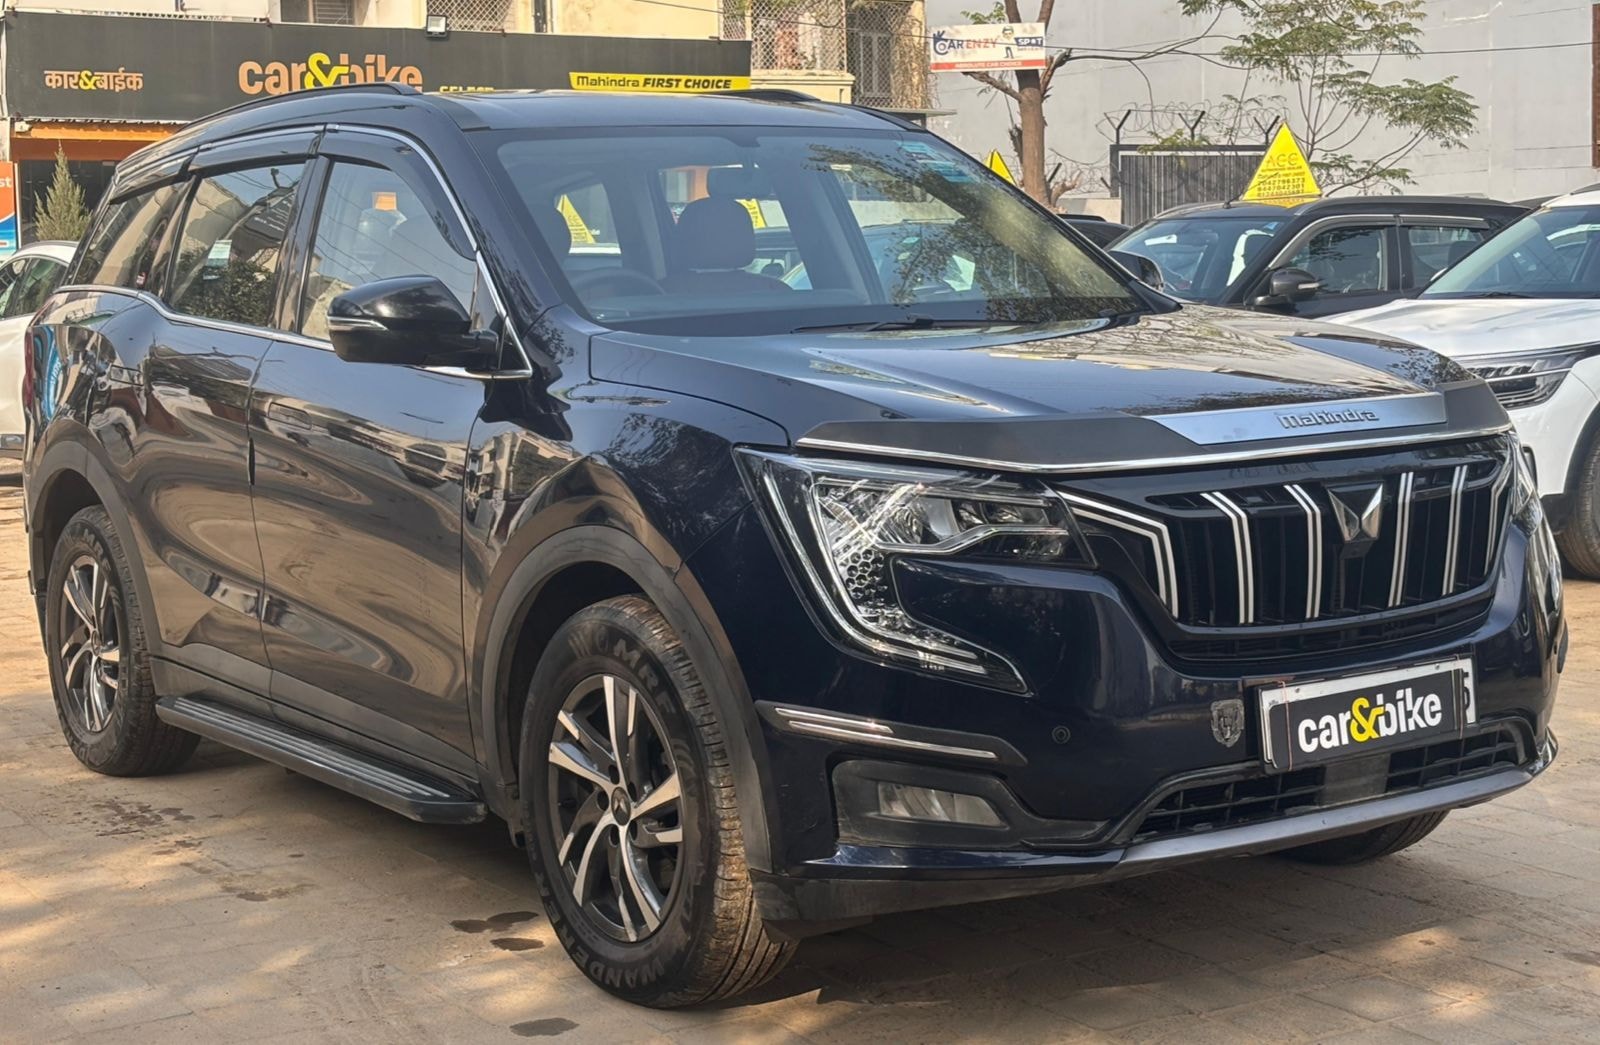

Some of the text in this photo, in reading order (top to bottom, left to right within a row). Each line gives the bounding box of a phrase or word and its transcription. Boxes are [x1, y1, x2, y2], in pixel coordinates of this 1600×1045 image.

[43, 67, 144, 92] कार&बाईक
[238, 52, 423, 94] car&bike
[576, 76, 731, 89] Mahindra FIRST CHOICE
[612, 637, 677, 714] MRF
[1297, 687, 1442, 753] car&bike
